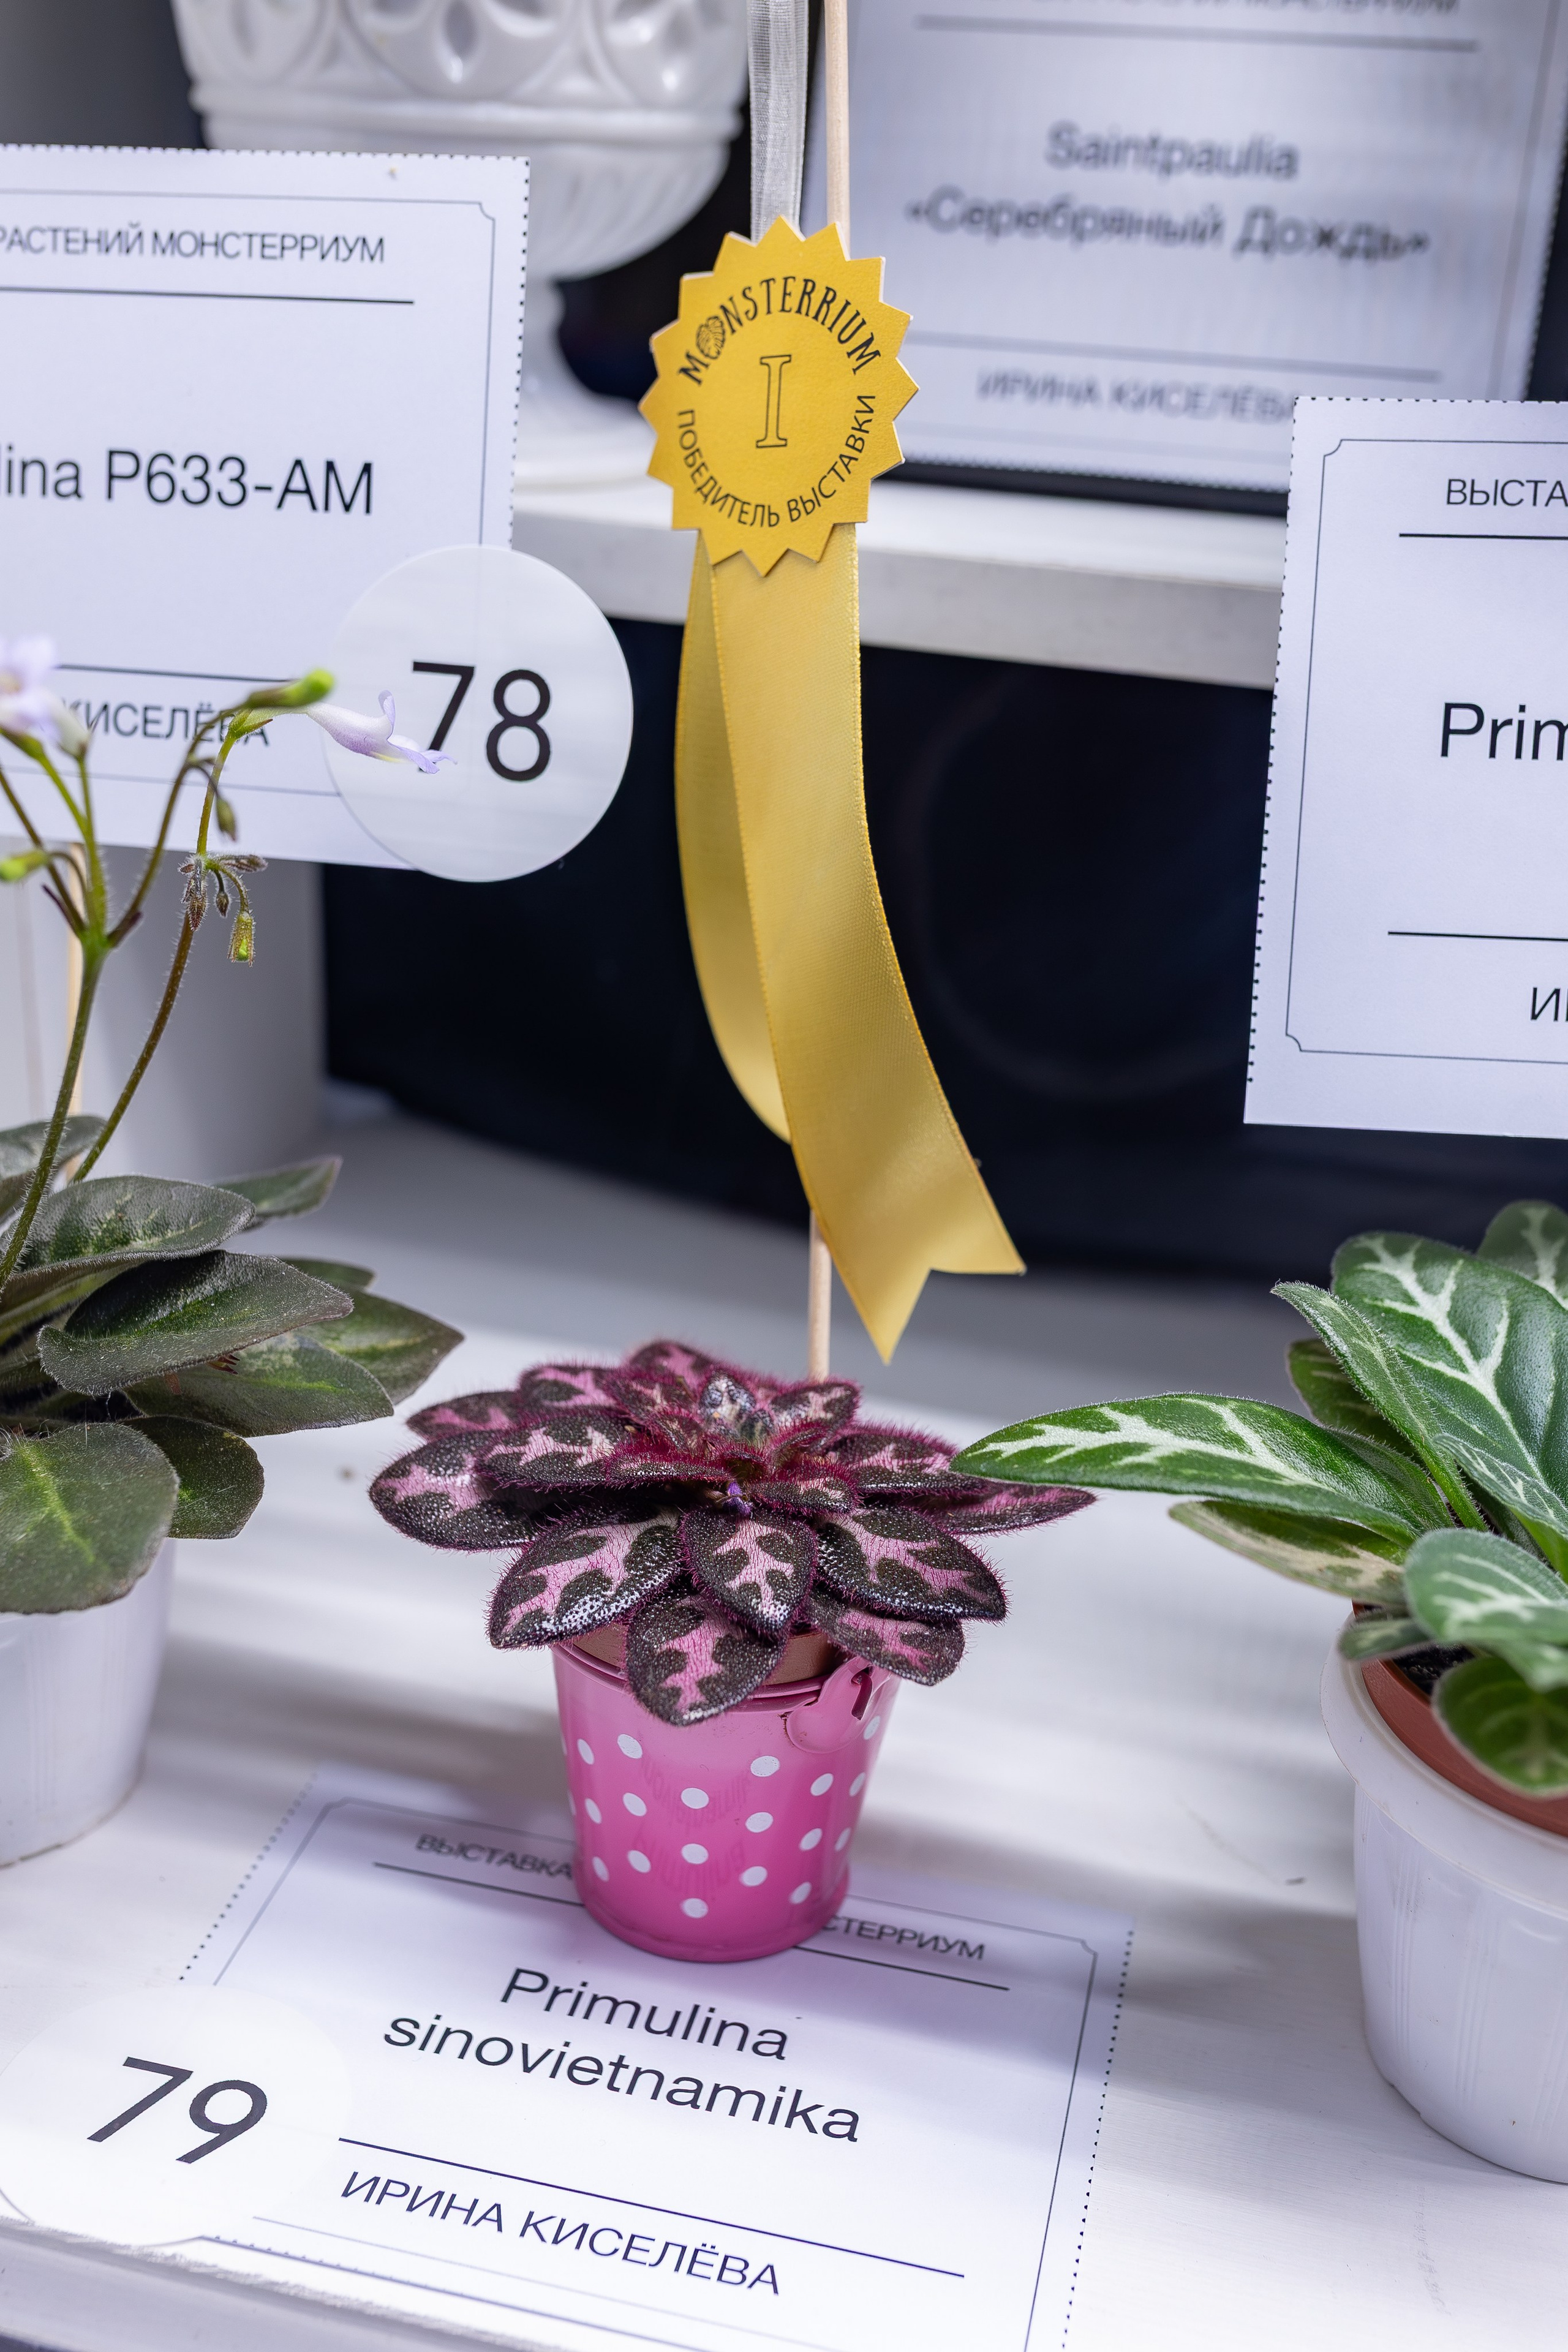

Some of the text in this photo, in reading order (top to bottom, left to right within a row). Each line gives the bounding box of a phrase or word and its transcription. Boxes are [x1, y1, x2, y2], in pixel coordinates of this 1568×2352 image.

[1046, 120, 1300, 180] Saintpaulia
[153, 231, 385, 263] МОНСТЕРРИУМ
[756, 354, 792, 448] I
[1110, 376, 1294, 423] КИСЕЛЁВ
[0, 442, 372, 515] ina P633-AM
[678, 394, 876, 528] ПОБЕДИТЕЛЬ ВЫСТАВКИ
[1447, 478, 1568, 507] ВЫСТА
[413, 661, 551, 782] 78
[415, 1834, 573, 1880] ВЫСТАВКА
[499, 1967, 790, 2061] Primulina
[87, 2057, 268, 2164] 79
[383, 2013, 861, 2143] sinovietnamika
[341, 2171, 782, 2297] ИРИНА КИСЕЛЁВА
